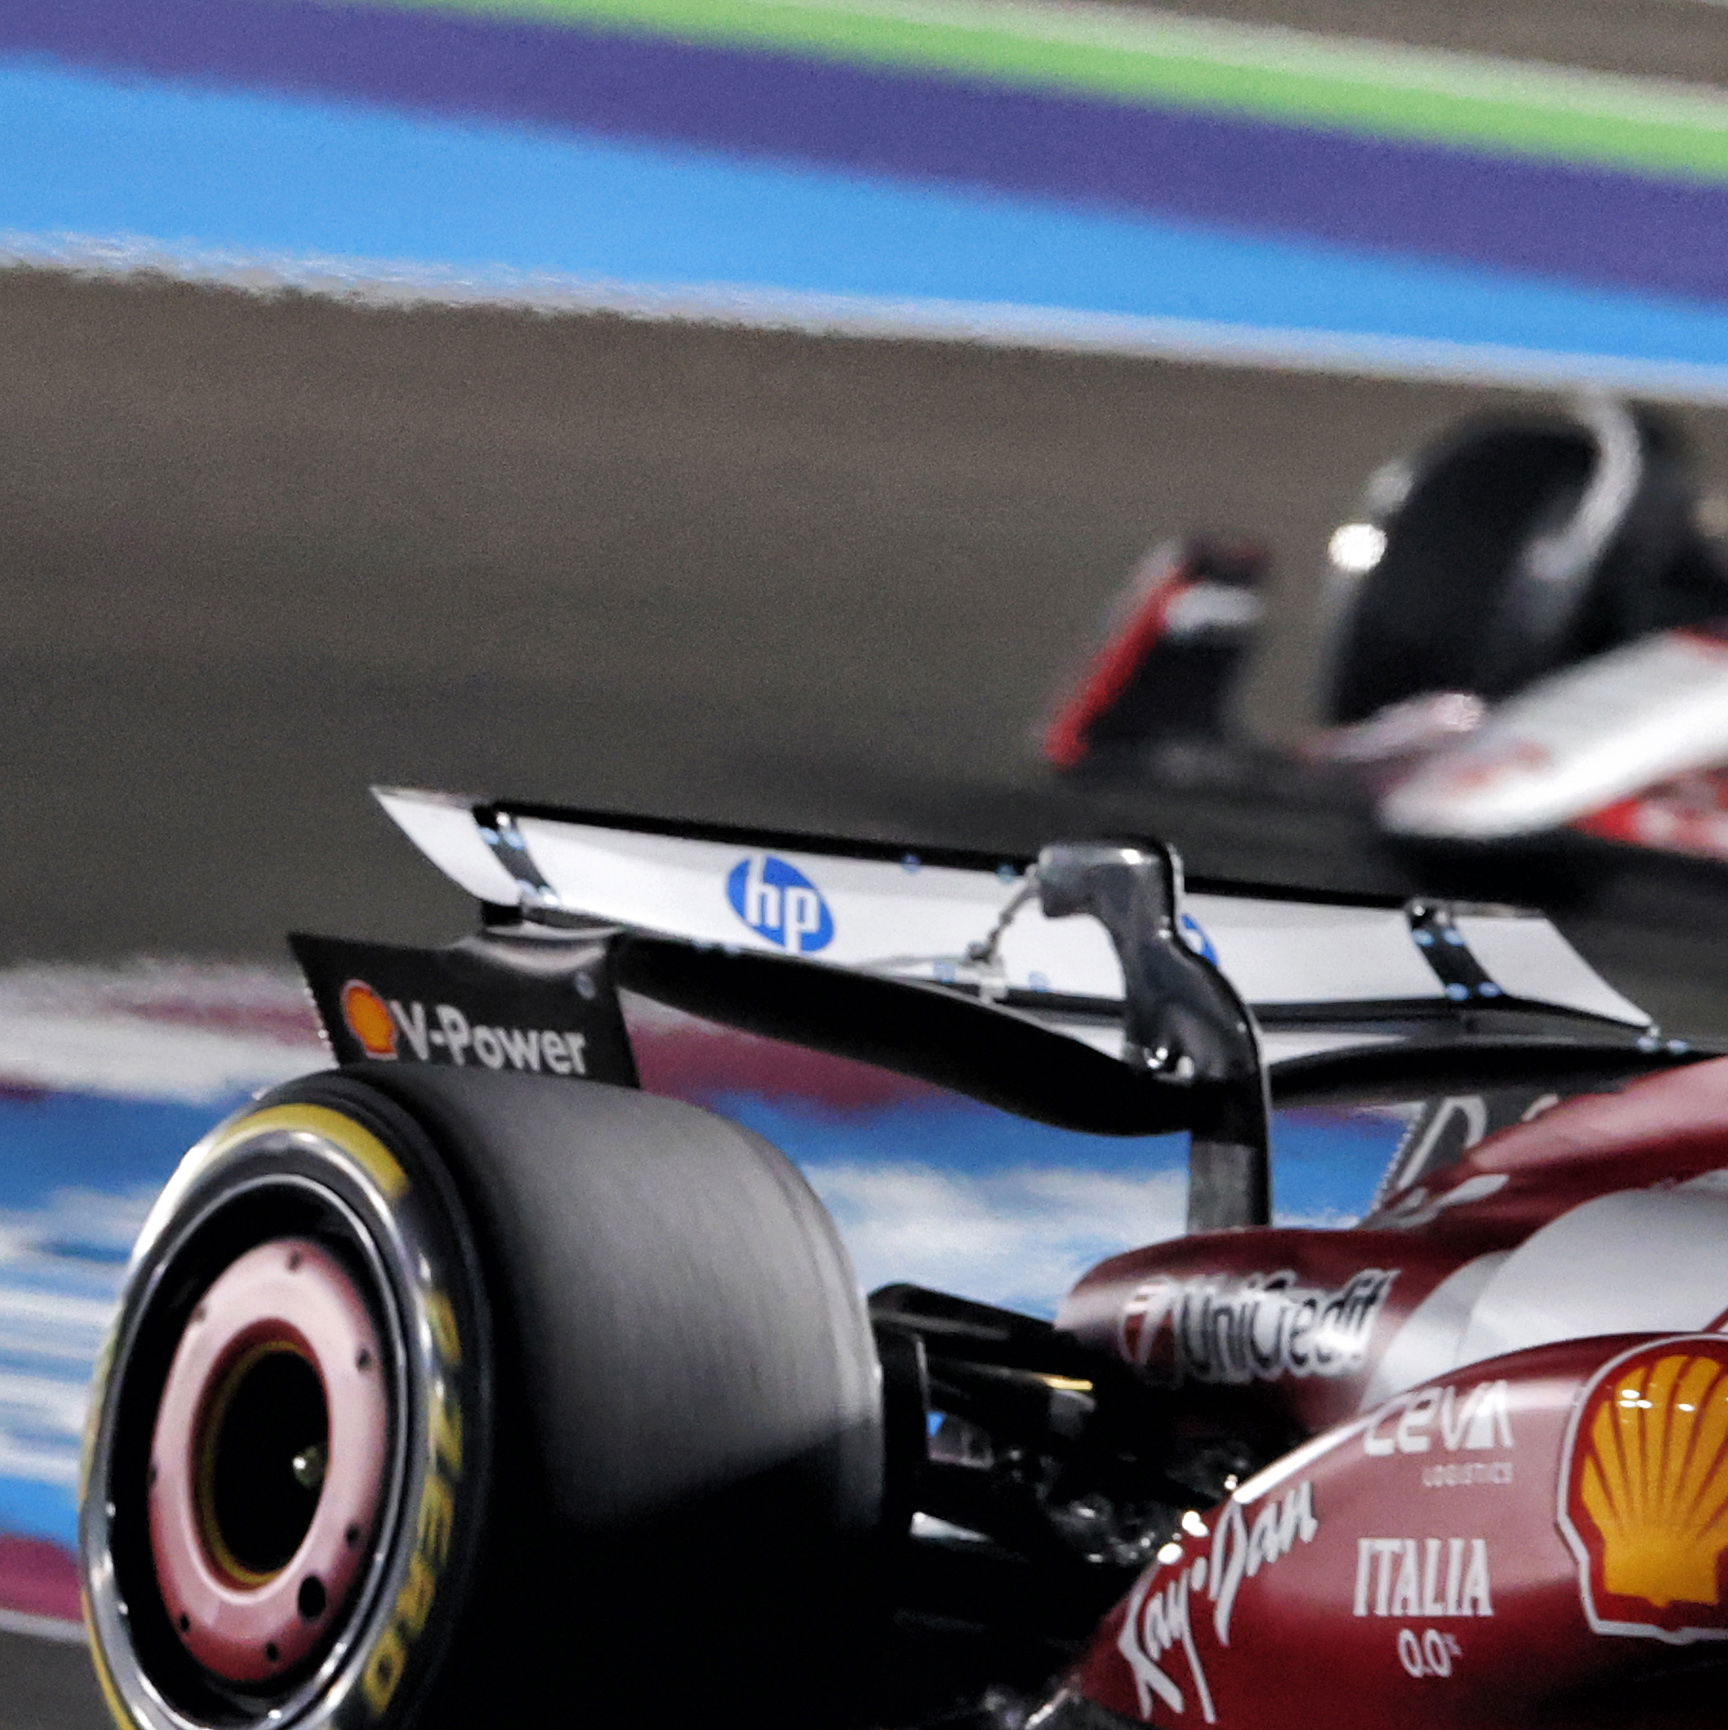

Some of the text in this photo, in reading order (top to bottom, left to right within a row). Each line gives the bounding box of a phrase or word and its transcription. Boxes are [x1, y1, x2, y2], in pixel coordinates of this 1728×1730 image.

[744, 856, 820, 953] hp
[389, 1000, 587, 1076] V-Power
[1352, 1536, 1495, 1617] ITALIA
